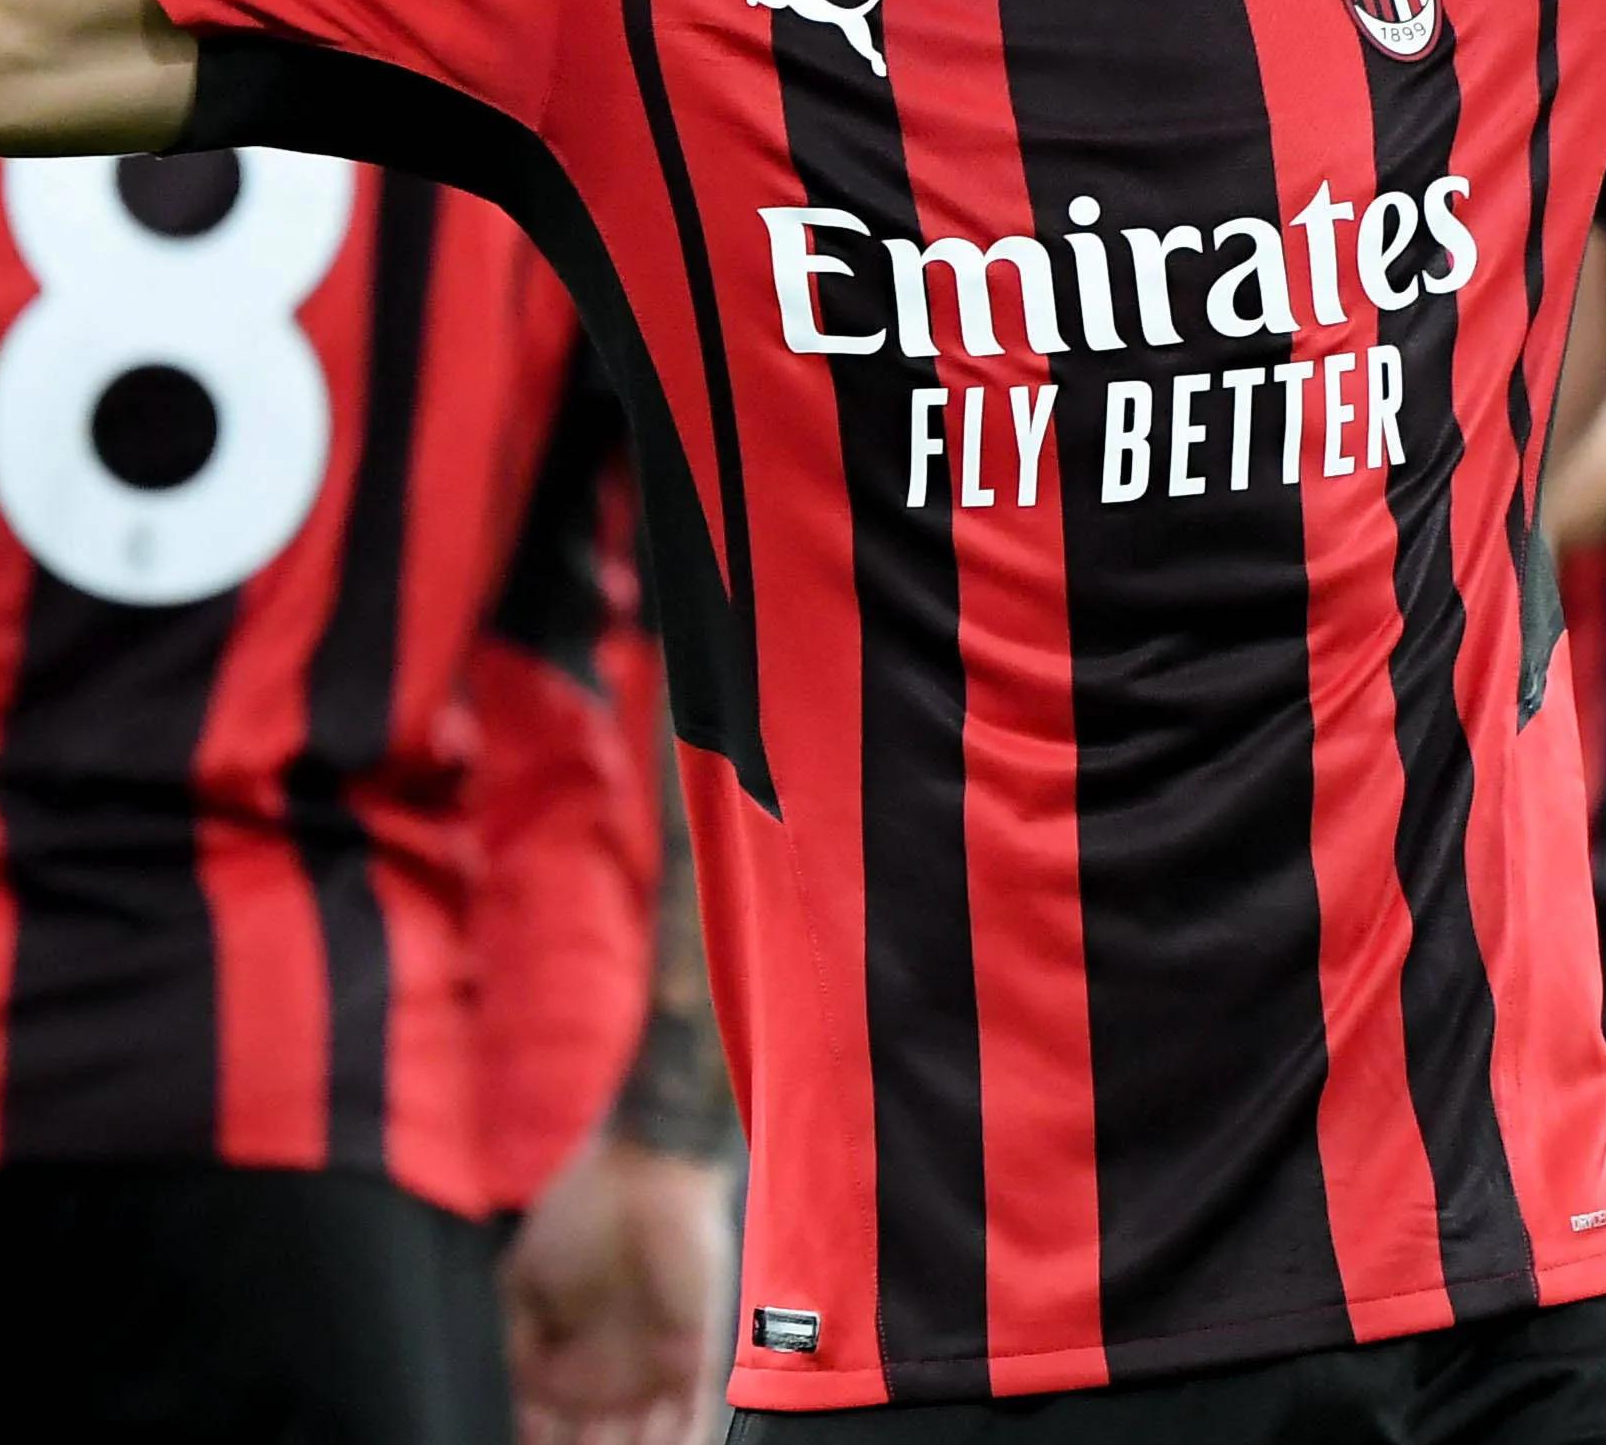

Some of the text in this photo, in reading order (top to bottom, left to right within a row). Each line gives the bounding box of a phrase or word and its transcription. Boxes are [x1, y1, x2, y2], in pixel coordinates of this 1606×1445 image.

[1380, 21, 1427, 43] 1899
[757, 175, 1478, 358] Emirates
[907, 345, 1407, 509] FLY BETTER
